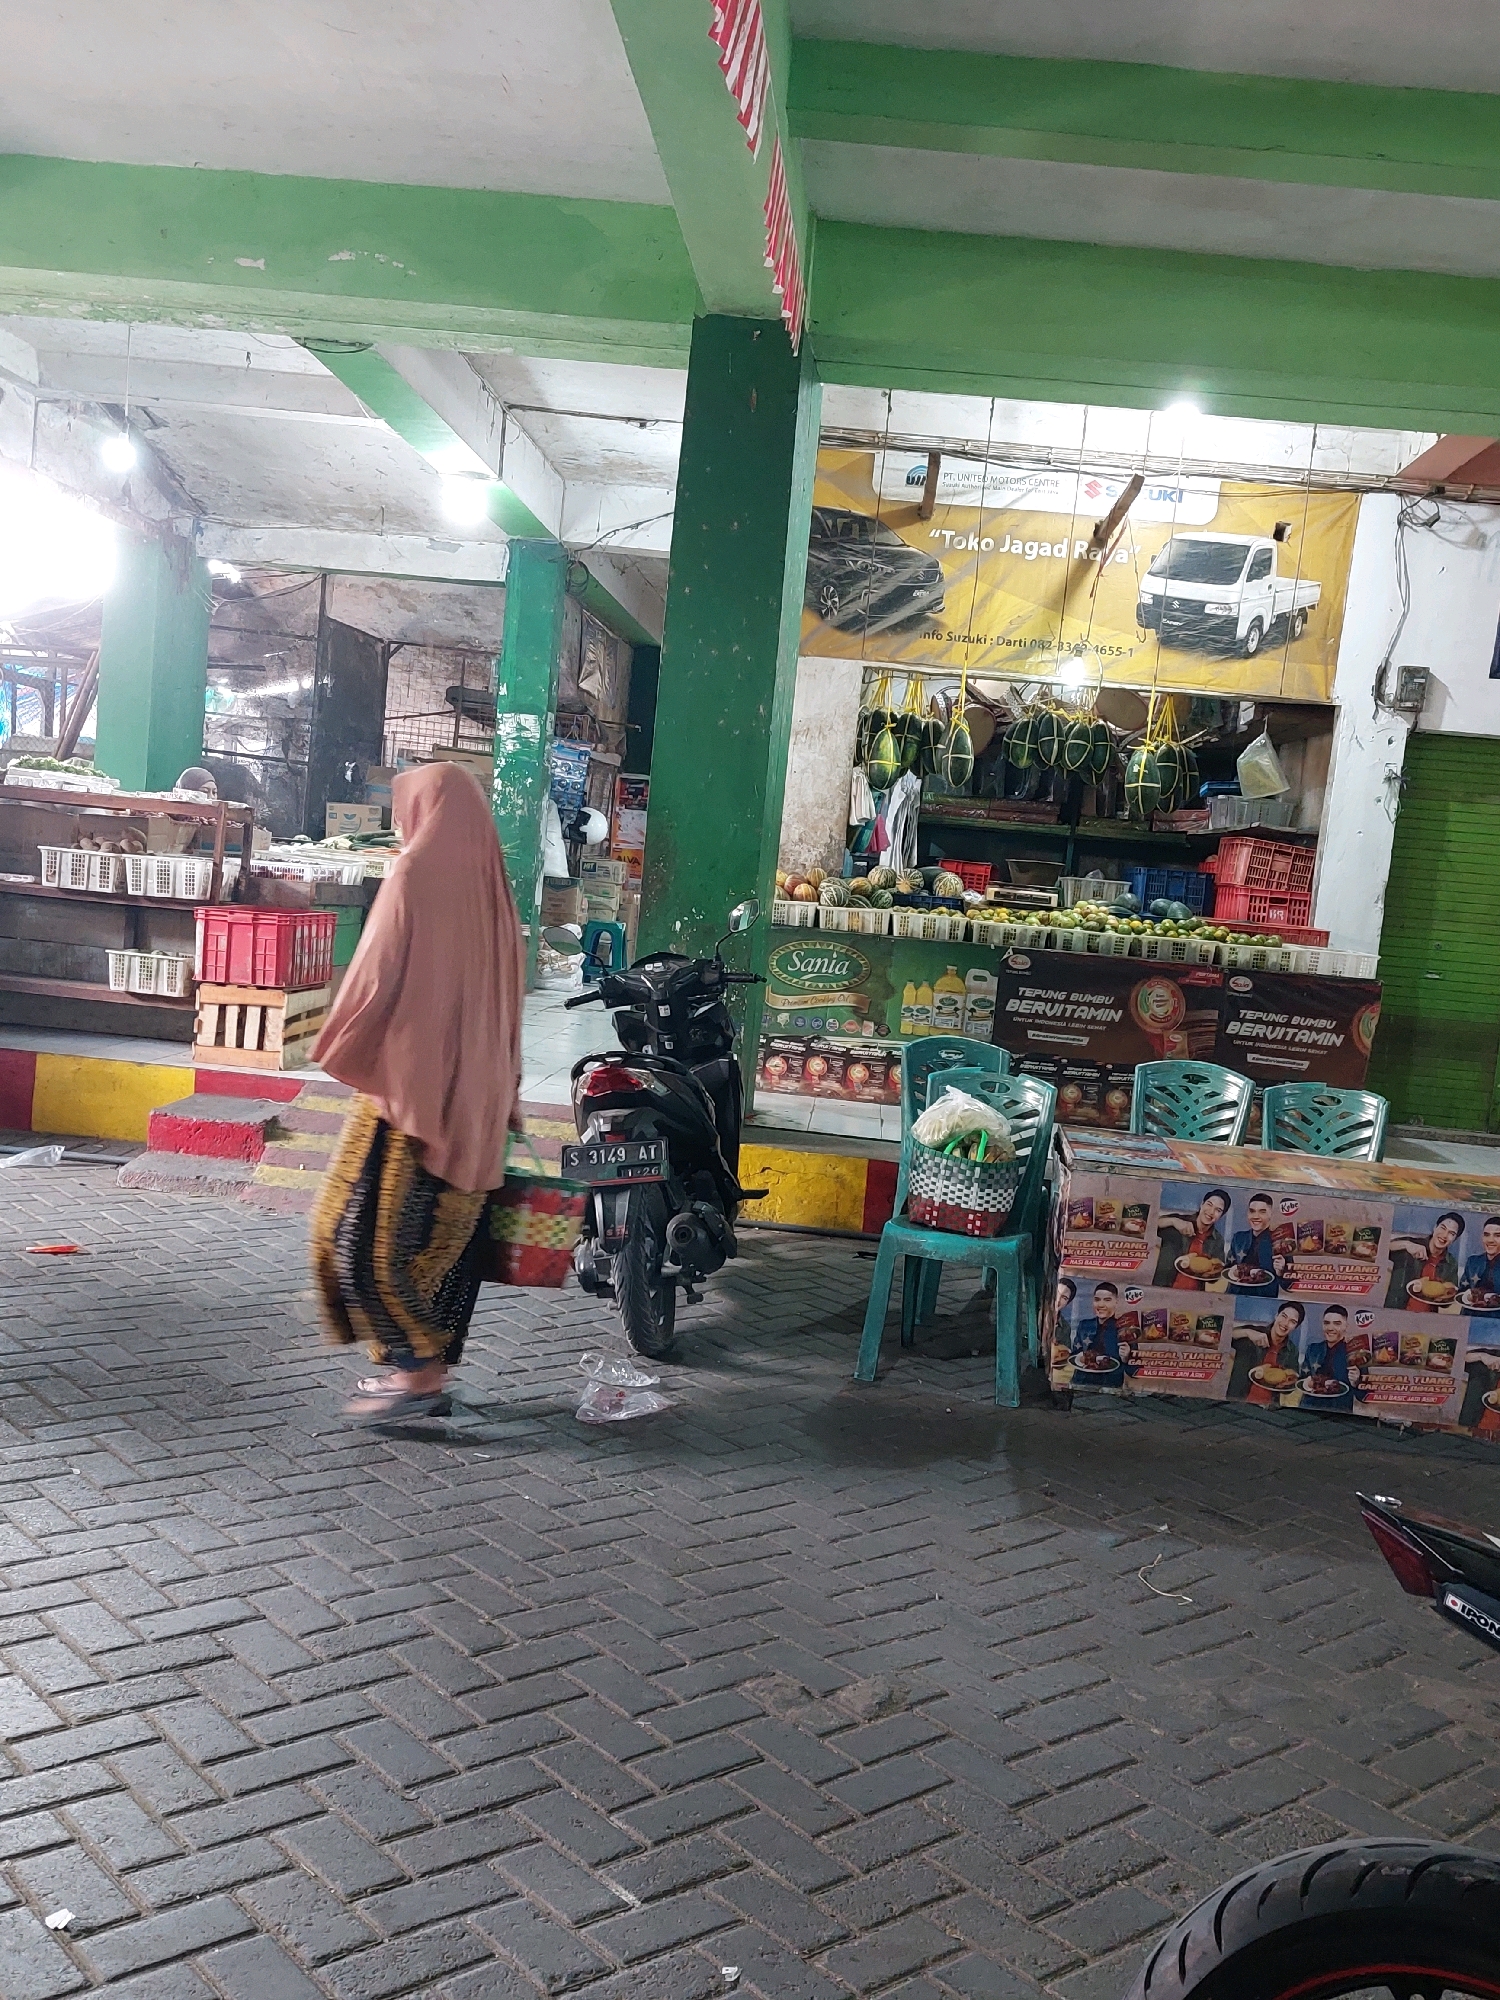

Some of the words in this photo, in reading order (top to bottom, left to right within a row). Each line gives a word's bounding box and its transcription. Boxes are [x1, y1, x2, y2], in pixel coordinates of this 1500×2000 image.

[943, 472, 955, 481] PT.
[957, 473, 988, 483] UNITED
[990, 475, 1027, 486] MOTORS
[1028, 478, 1060, 488] CENTRE
[1105, 484, 1184, 504] SUKI
[999, 533, 1070, 561] Jagad
[946, 630, 987, 646] Suzuki
[996, 635, 1027, 648] Darti
[787, 950, 851, 976] Sania
[1018, 986, 1068, 1000] TEPUNG
[1069, 992, 1115, 1005] BUMBU
[1005, 998, 1123, 1022] BERVITAMIN
[1034, 1018, 1067, 1027] INDONESIA
[1068, 1021, 1087, 1029] LEBIH
[1238, 1009, 1289, 1023] TEPUNG
[1290, 1015, 1337, 1029] BUMBU
[1225, 1021, 1345, 1048] BERVITAMIN
[1254, 1042, 1287, 1050] INDONESIA
[570, 1151, 580, 1167] S
[588, 1147, 626, 1165] 3149
[639, 1144, 658, 1160] AT
[1281, 1201, 1299, 1212] Kobe
[1063, 1240, 1105, 1249] INGGAL
[1108, 1241, 1148, 1250] TUANG
[1075, 1249, 1104, 1257] USAH
[1104, 1251, 1149, 1259] DIMASAK
[1286, 1263, 1335, 1273] TINGGAL
[1339, 1265, 1380, 1274] TUANG
[1282, 1272, 1304, 1280] GAK
[1305, 1273, 1335, 1281] USAH
[1335, 1274, 1381, 1283] DIMASAK
[1125, 1291, 1143, 1301] Kobe
[1356, 1313, 1374, 1324] Kobe
[1130, 1350, 1179, 1359] TINGGAL
[1182, 1352, 1222, 1360] TUANG
[1178, 1360, 1223, 1369] DIMASAK
[1360, 1374, 1410, 1383] TINGGAL
[1413, 1376, 1455, 1385] TUANG
[1380, 1384, 1409, 1392] USAH
[1409, 1385, 1456, 1394] DIMASAK
